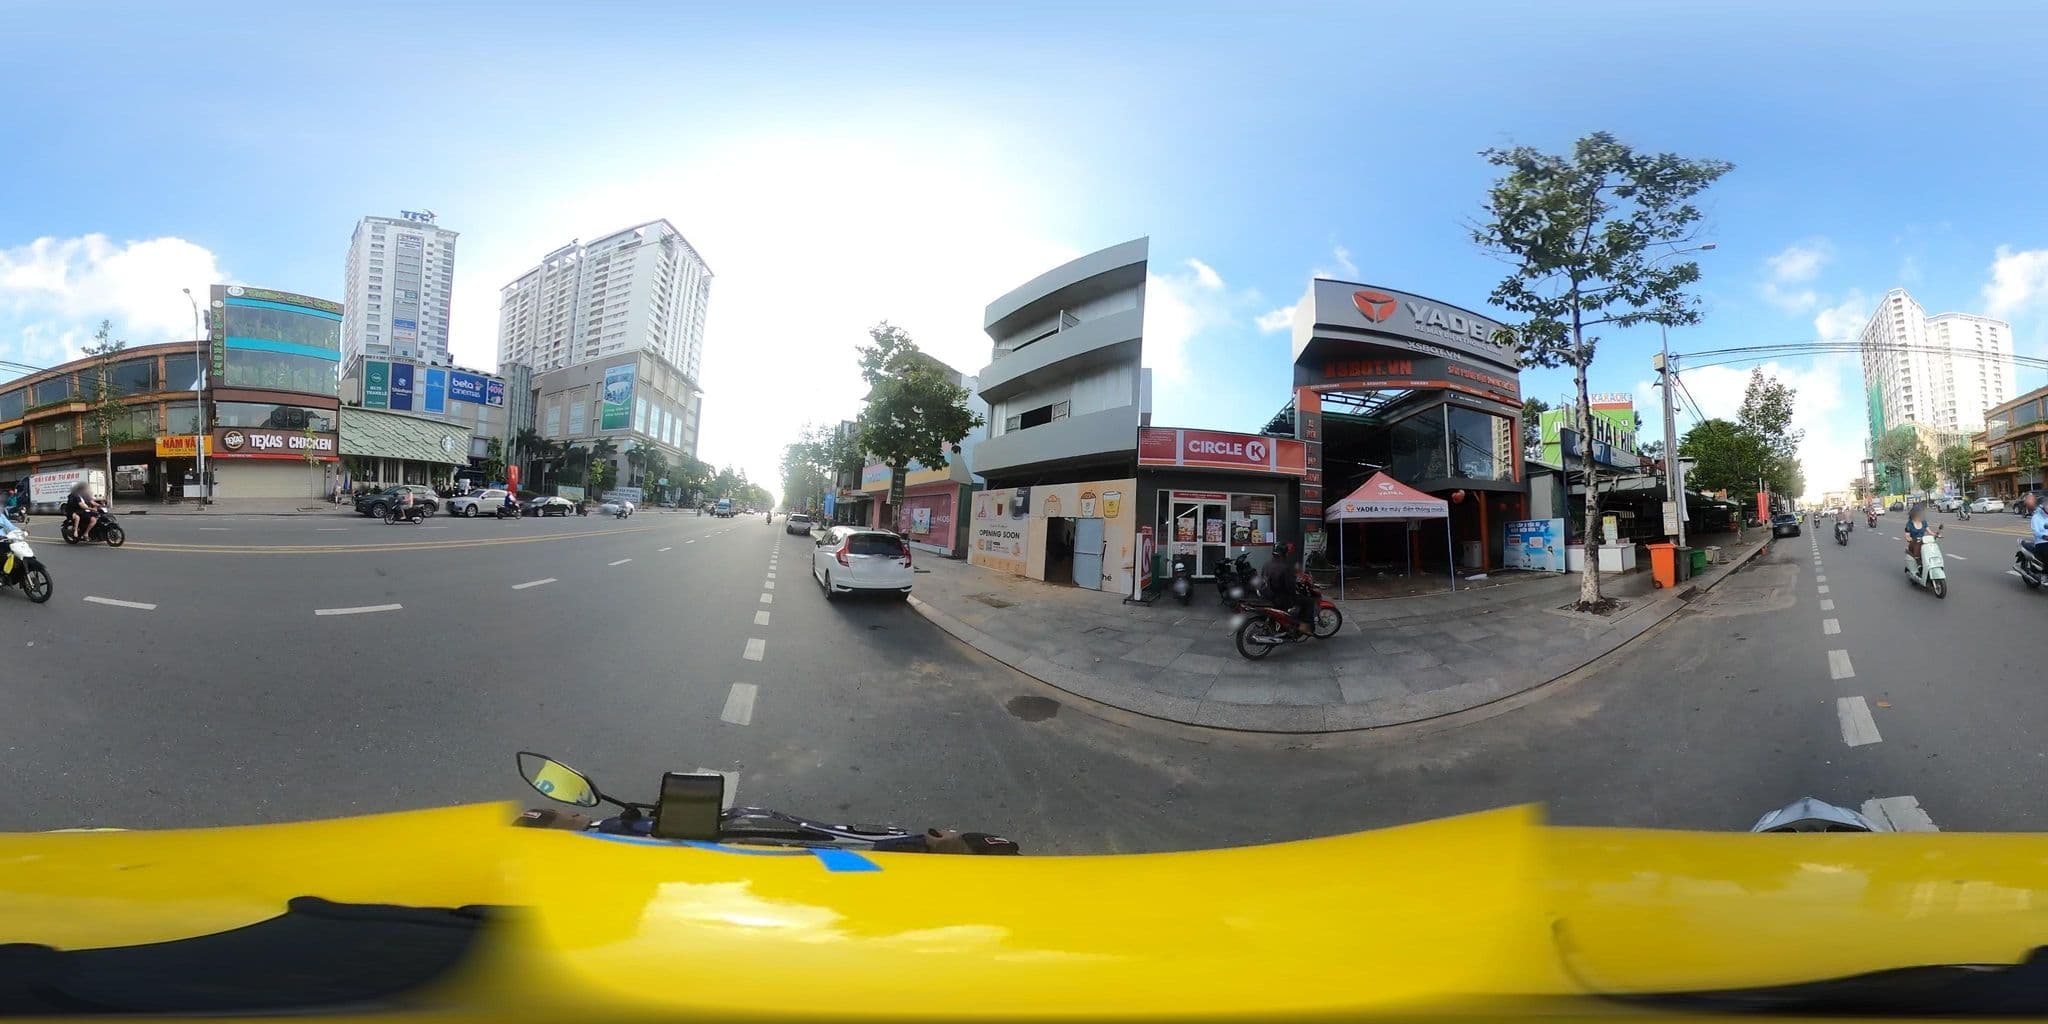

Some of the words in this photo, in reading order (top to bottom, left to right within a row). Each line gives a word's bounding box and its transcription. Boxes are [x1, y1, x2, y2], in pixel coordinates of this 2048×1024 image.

[1405, 301, 1504, 348] YADEA
[452, 377, 473, 389] beta
[452, 387, 480, 398] cinemas
[1591, 393, 1632, 403] KARAOKE
[250, 434, 283, 449] TEXAS
[288, 436, 332, 450] CHICKEN
[1188, 439, 1243, 456] CIRCLE
[1248, 443, 1265, 461] K
[979, 529, 1002, 538] OPENING
[1003, 530, 1020, 540] SOON
